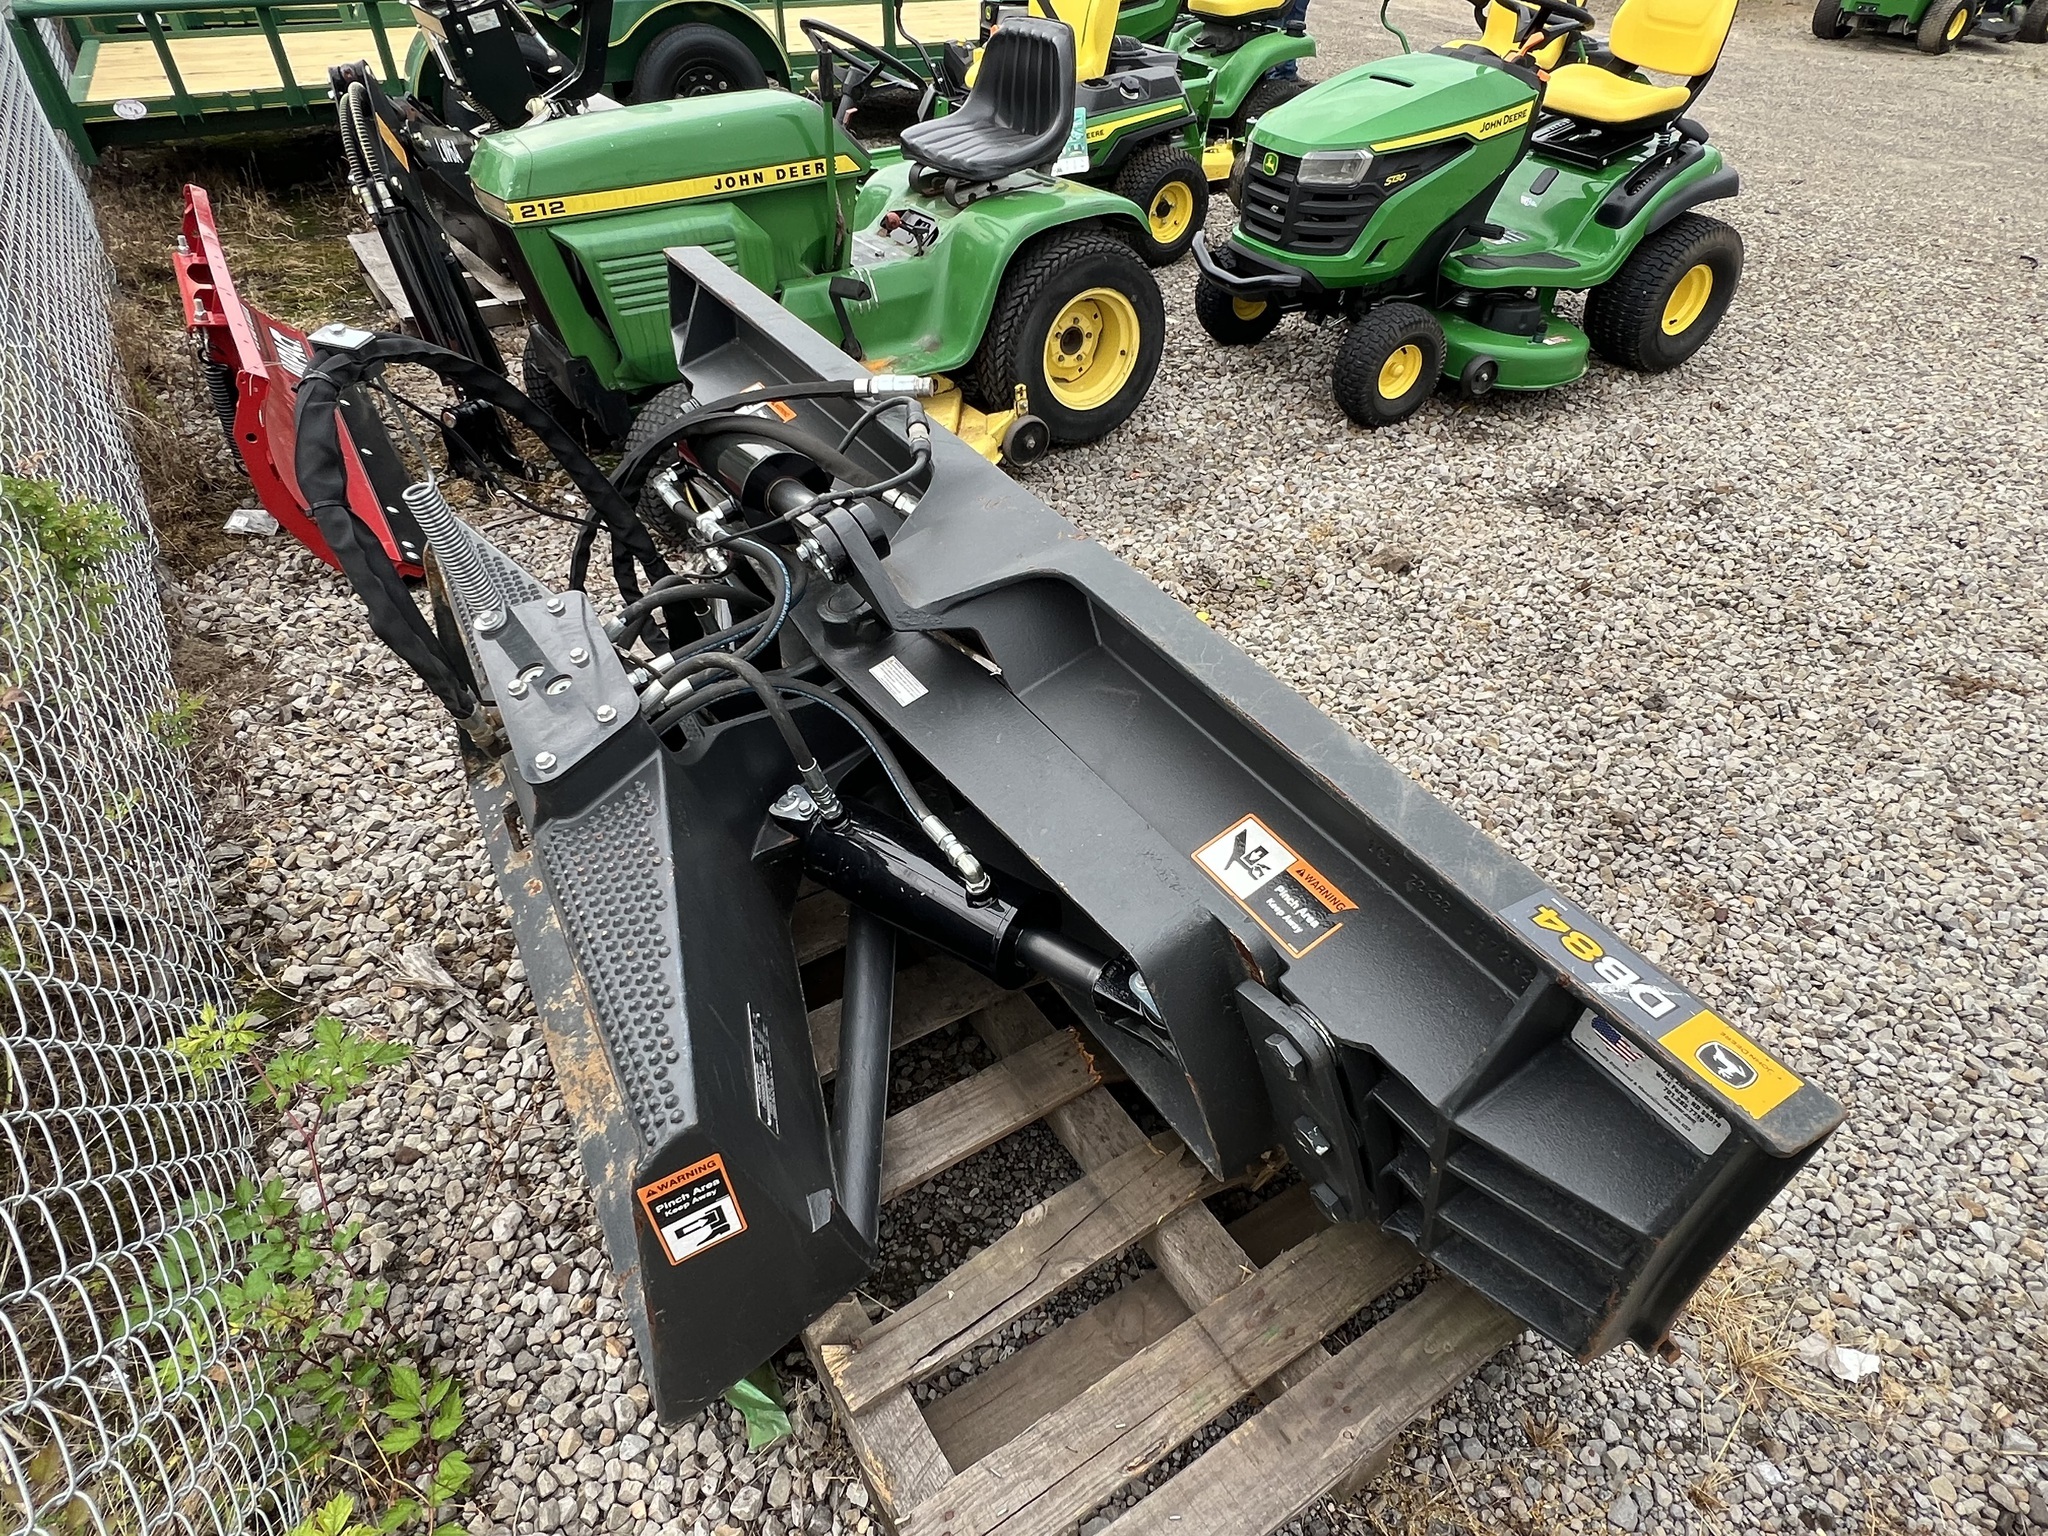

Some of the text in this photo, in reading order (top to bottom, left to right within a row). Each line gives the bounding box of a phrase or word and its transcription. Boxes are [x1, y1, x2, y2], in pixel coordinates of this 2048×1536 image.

[1086, 129, 1104, 139] EERE
[1480, 109, 1527, 133] JOHN DEERE
[714, 161, 837, 191] JOHN DEER
[520, 200, 567, 219] 212
[1274, 885, 1320, 929] Pinch Area
[1305, 873, 1346, 911] WARNING
[1266, 898, 1304, 934] Keep Away
[1531, 904, 1678, 1020] DB84
[1720, 1031, 1775, 1073] JOHN DEERE
[1655, 1070, 1671, 1087] West
[656, 1160, 717, 1192] WARNING
[655, 1178, 720, 1214] Pinch Area
[664, 1188, 718, 1218] Keep Away
